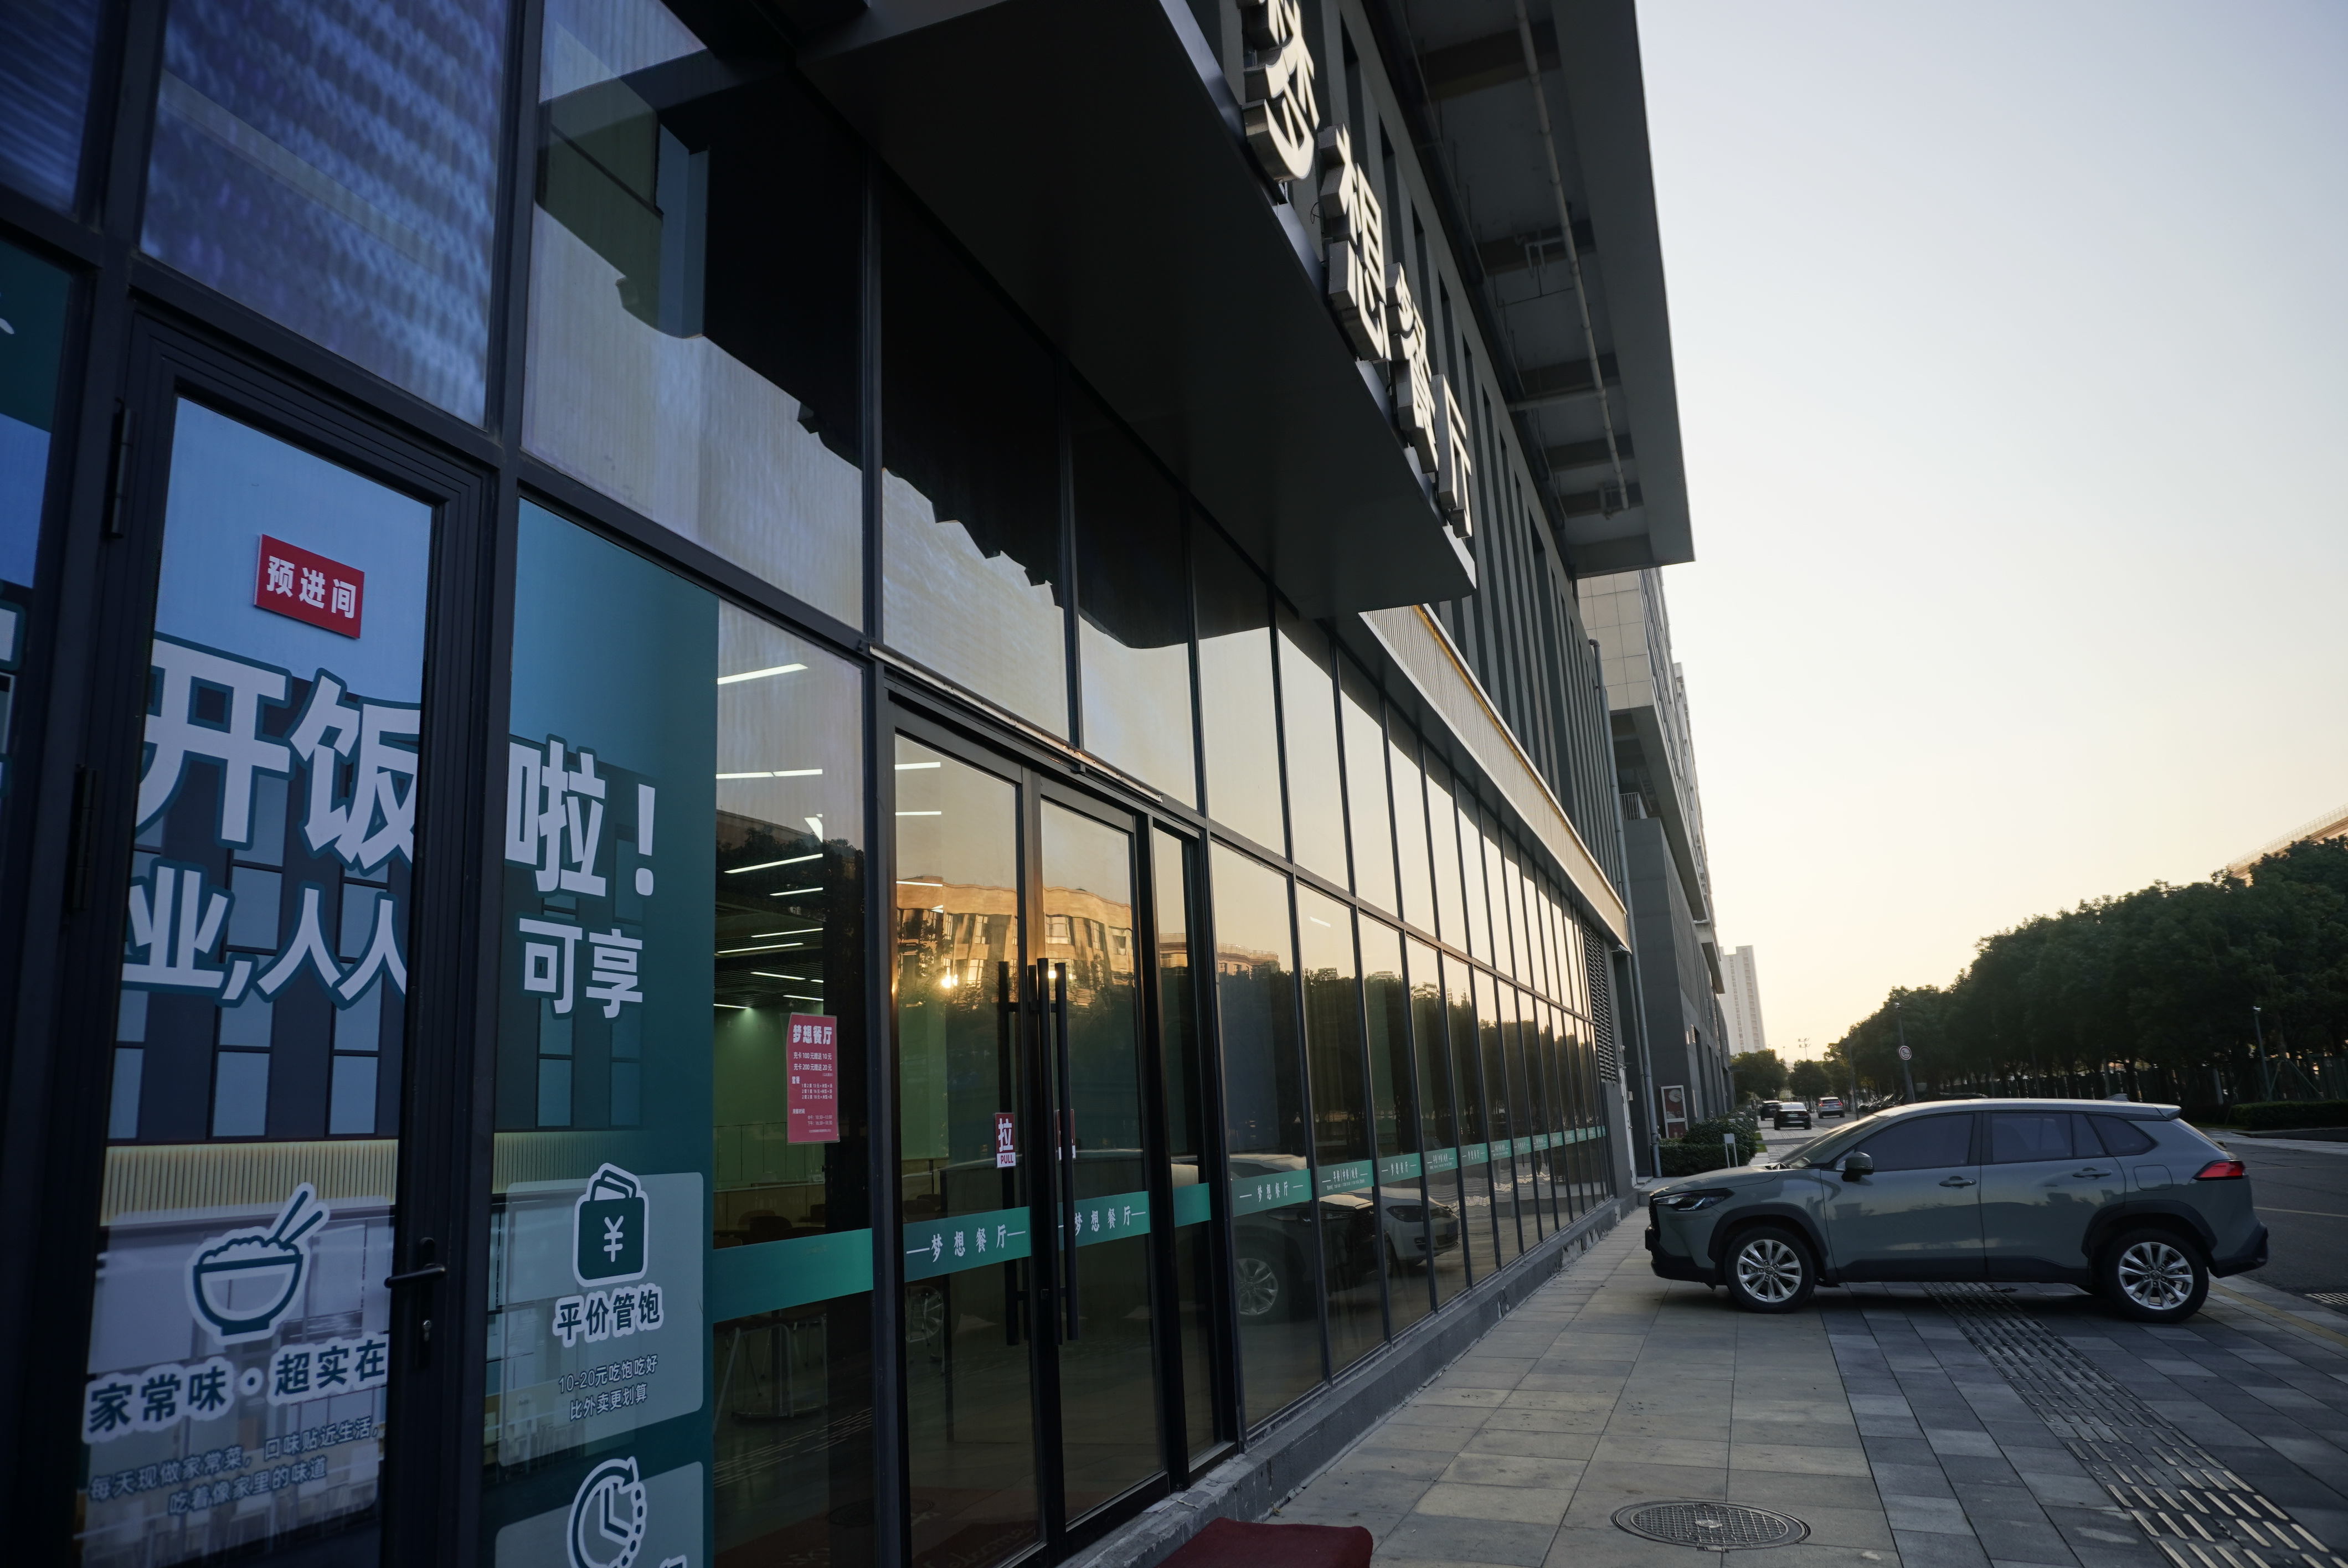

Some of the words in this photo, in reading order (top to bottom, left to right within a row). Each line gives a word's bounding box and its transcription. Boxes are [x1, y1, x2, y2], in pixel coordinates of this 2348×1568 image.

[267, 556, 356, 618] 预进间
[519, 917, 643, 1019] 可享
[792, 1024, 832, 1045] 梦想餐厅
[998, 1118, 1014, 1152] 拉
[1001, 1154, 1014, 1164] PULL
[1074, 1205, 1131, 1236] 梦想餐厅
[931, 1224, 1007, 1263] 梦想餐厅
[557, 1290, 662, 1341] 平价管饱
[559, 1354, 658, 1395] 10-20元吃饱吃好
[569, 1383, 647, 1422] 比外卖更划算
